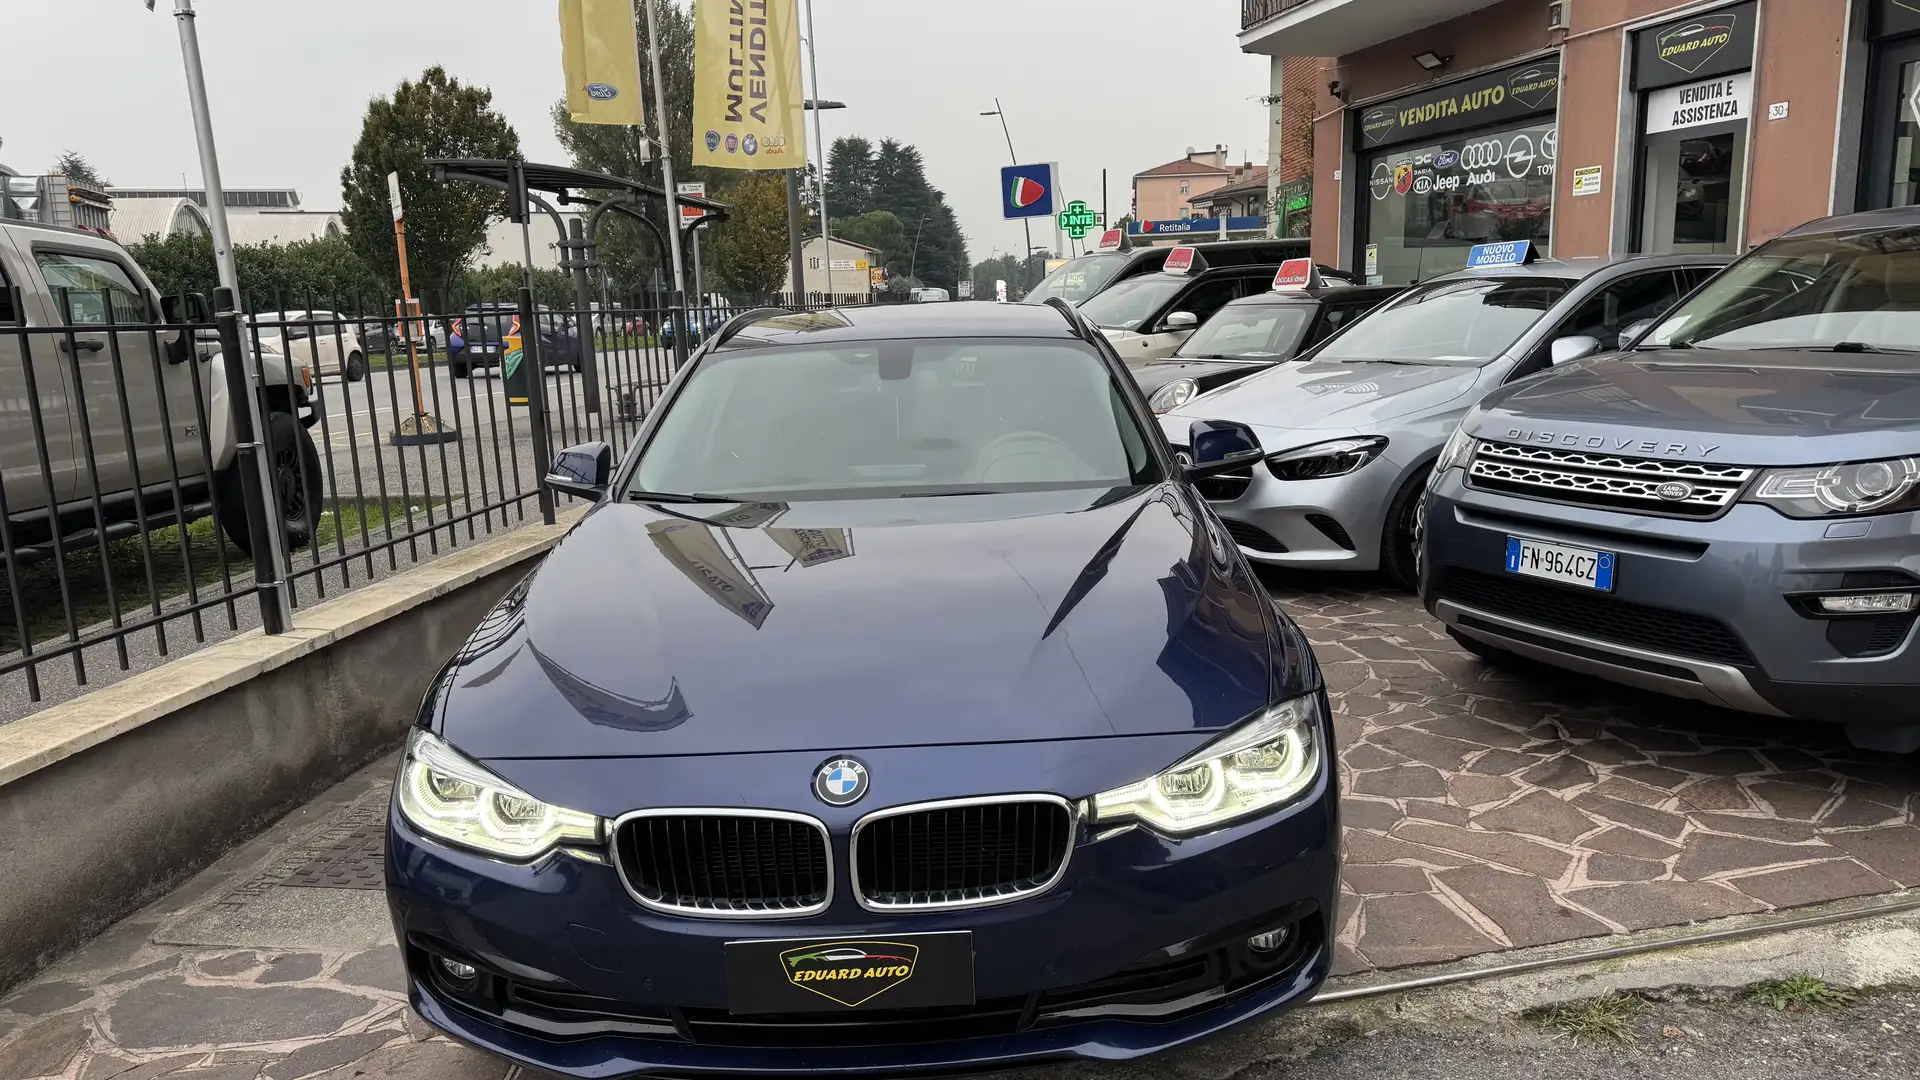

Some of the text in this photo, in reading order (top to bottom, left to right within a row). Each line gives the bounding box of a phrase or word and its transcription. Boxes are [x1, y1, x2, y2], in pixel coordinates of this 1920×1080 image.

[1661, 32, 1728, 57] EDUARD AUTO
[1511, 77, 1557, 95] EDUARD AUTO
[1679, 80, 1734, 105] VENDITA E
[1400, 85, 1505, 127] VENDITA AUTO
[1672, 100, 1738, 126] ASSISTENZA
[1772, 105, 1784, 116] 30
[1413, 168, 1432, 176] DACIA
[1466, 170, 1496, 187] Audi
[1369, 176, 1394, 186] NISSAN
[1415, 179, 1430, 191] KIA
[1432, 174, 1460, 191] Jeep
[1159, 223, 1191, 232] Retitalia
[1482, 244, 1515, 255] NUOVO
[1475, 252, 1516, 264] MODELLO
[1276, 275, 1306, 284] OCCASIONE
[1505, 427, 1720, 458] DISCOVERY
[821, 759, 864, 775] BMW
[793, 964, 910, 982] EDUARD AUTO
